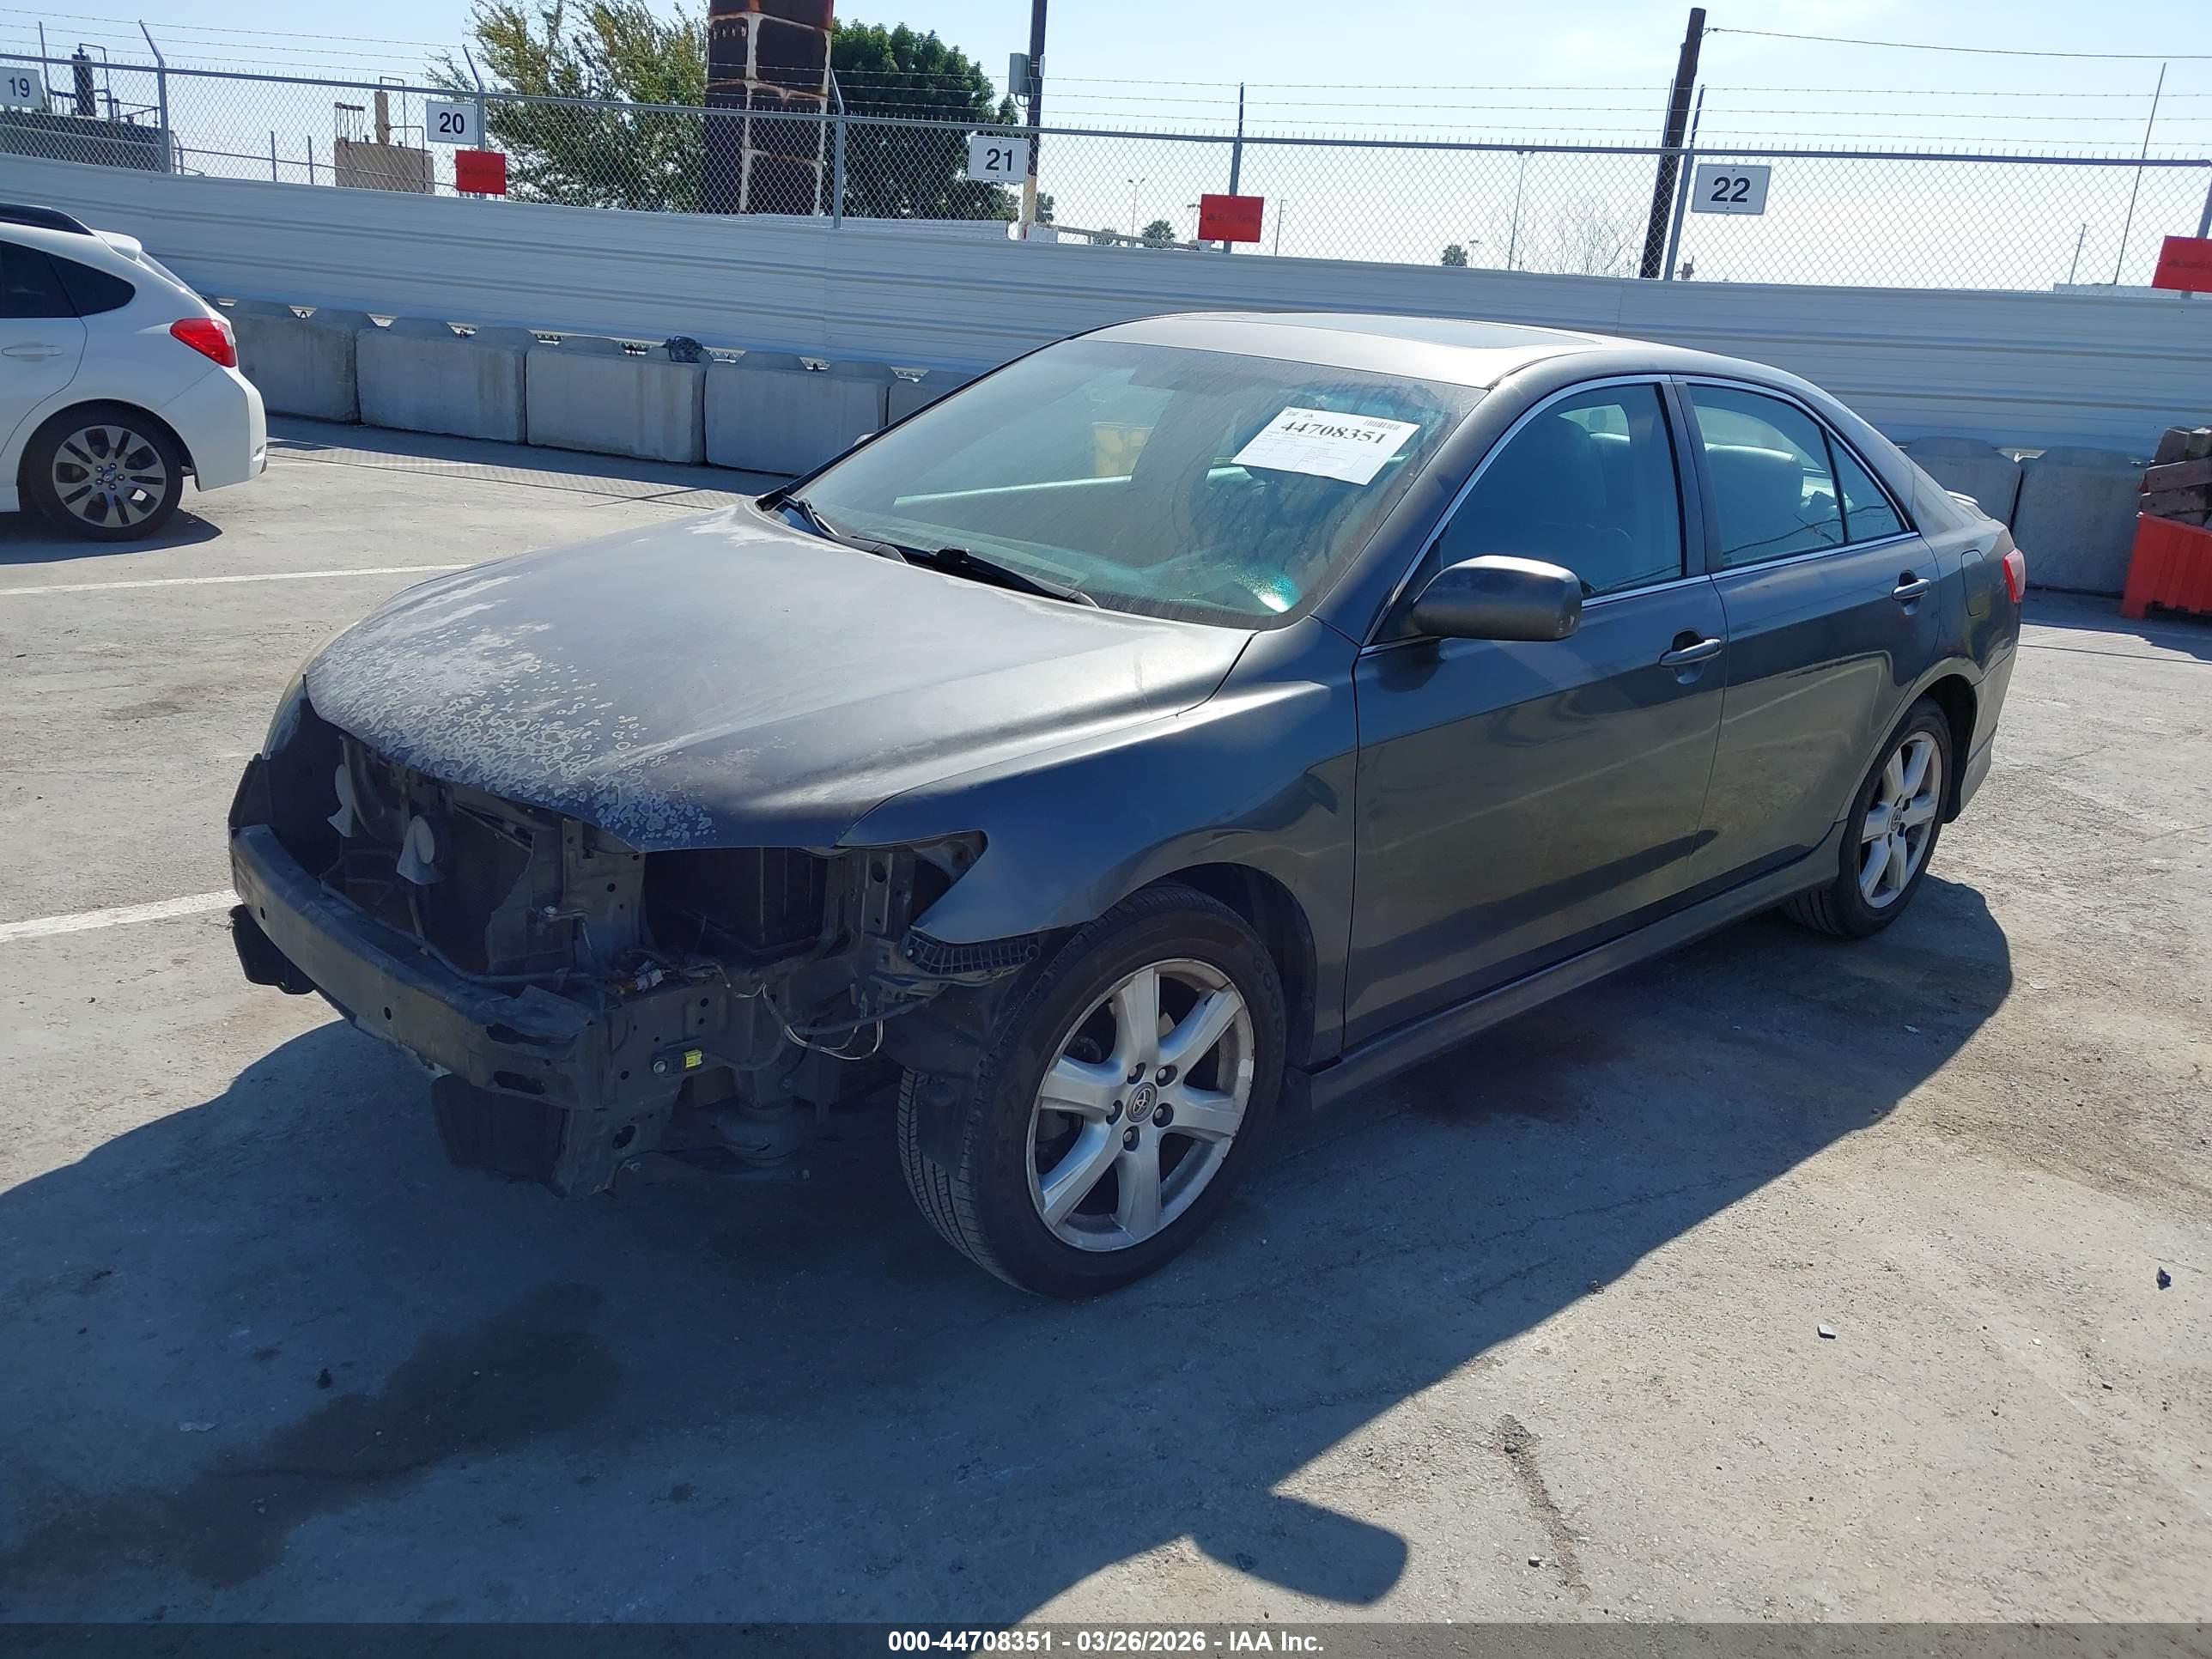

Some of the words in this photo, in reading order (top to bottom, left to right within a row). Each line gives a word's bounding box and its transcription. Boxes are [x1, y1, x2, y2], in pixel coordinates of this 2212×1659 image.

[9, 77, 30, 98] 19
[439, 112, 465, 135] 20
[985, 148, 1013, 172] 21
[1710, 176, 1751, 204] 22
[1280, 421, 1388, 444] 44708351
